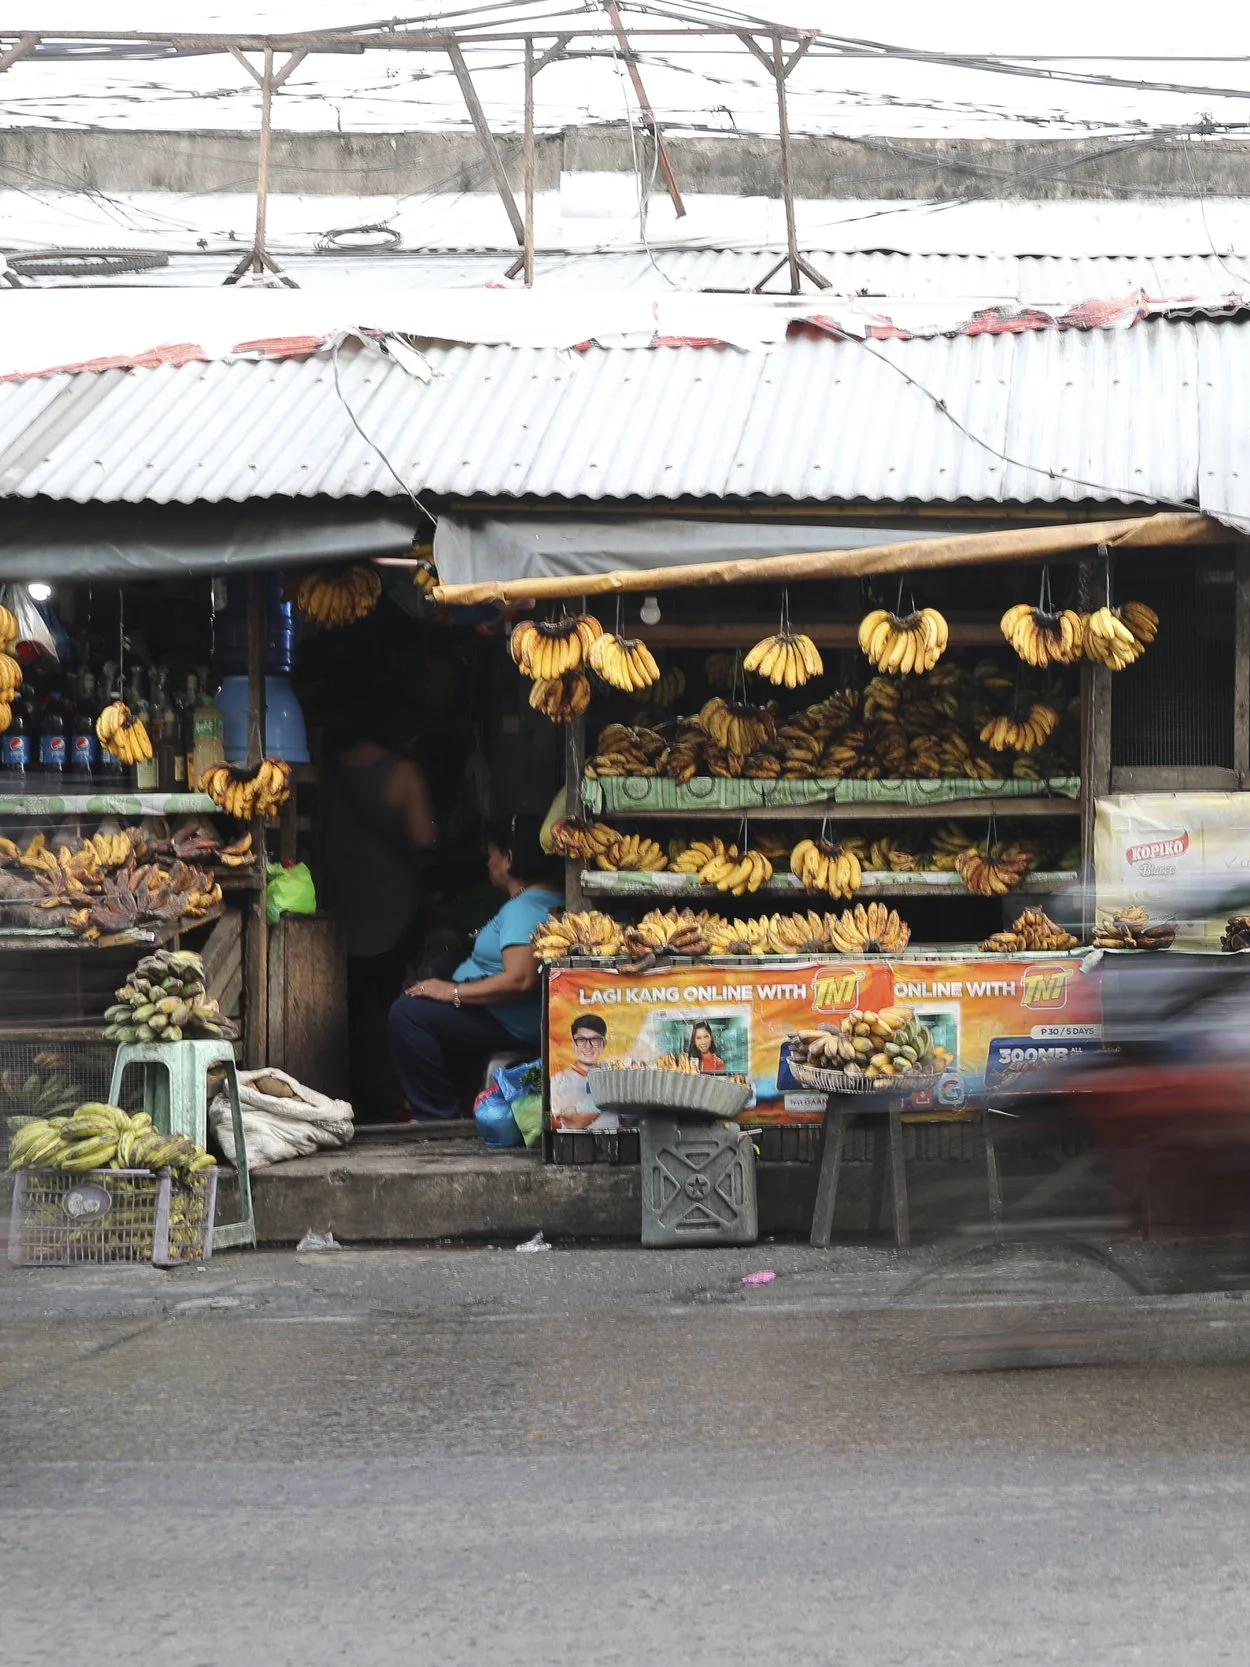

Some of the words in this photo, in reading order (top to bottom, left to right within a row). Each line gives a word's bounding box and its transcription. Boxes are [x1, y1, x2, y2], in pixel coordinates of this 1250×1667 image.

[1132, 840, 1184, 861] KOPIKO
[579, 988, 621, 1005] LAGI
[626, 986, 680, 1003] KANG
[683, 984, 753, 1002] ONLINE
[756, 983, 807, 1000] WITH
[812, 973, 865, 1007] TNT
[893, 981, 963, 998] ONLINE
[962, 981, 1016, 998] WITH
[1021, 969, 1073, 1006] TNT
[1072, 1027, 1095, 1035] DAYS
[998, 1047, 1069, 1064] 300MB
